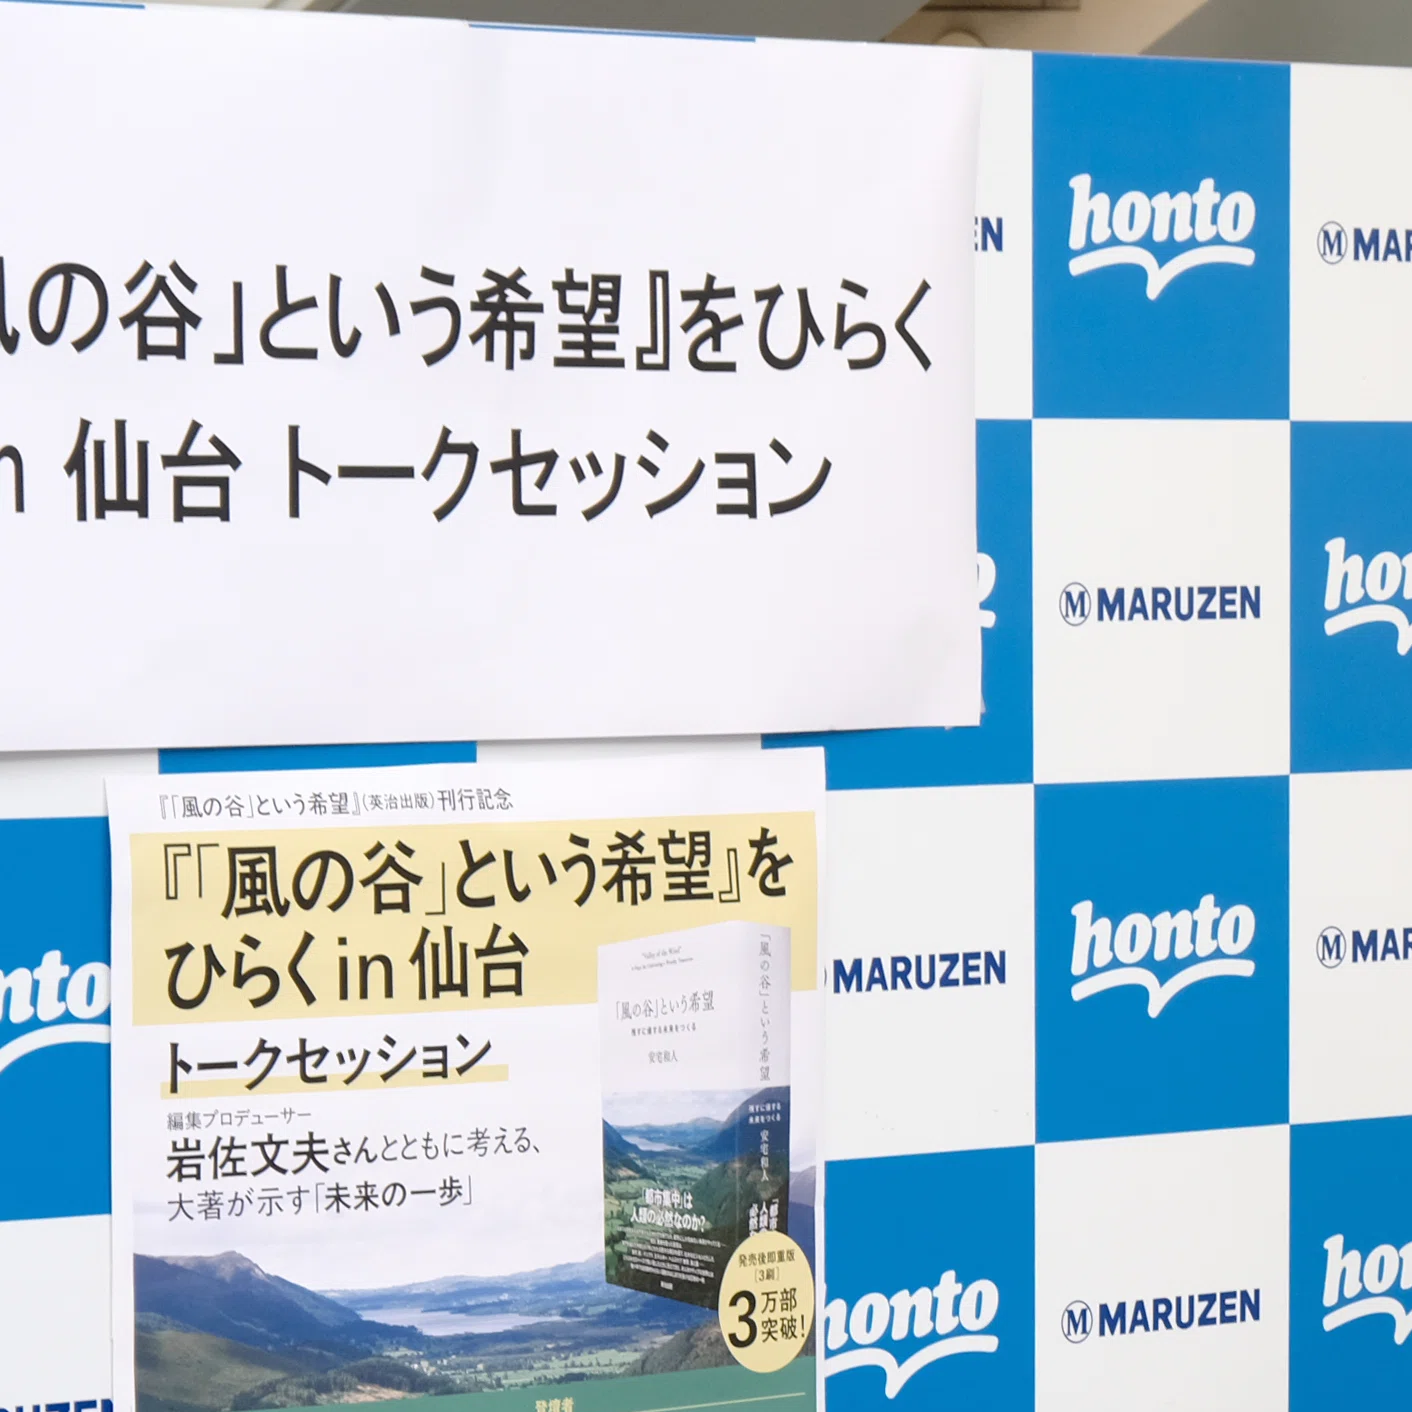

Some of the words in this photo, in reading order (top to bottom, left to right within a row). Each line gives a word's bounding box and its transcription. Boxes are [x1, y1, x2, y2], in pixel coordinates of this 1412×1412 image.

[1069, 173, 1256, 249] honto
[0, 258, 933, 373] の谷」という希望』をひらく
[63, 419, 242, 523] 仙台
[288, 424, 832, 522] トークセッション
[1097, 585, 1261, 622] MARUZEN
[164, 825, 795, 920] 『「風の谷」という希望』を
[1071, 894, 1256, 977] honto
[0, 950, 110, 1024] nto
[832, 950, 1007, 994] MARUZEN
[615, 990, 715, 1021] 「風の谷」という希望
[759, 933, 772, 1081] 「風の谷」という希望
[169, 1034, 492, 1094] トークセッション
[167, 1107, 312, 1131] 編集プロデューサー
[166, 1126, 540, 1182] 岩佐文夫さんとともに考える、
[168, 1175, 473, 1222] 大著が示す「未来の一歩」
[727, 1290, 758, 1348] 3
[761, 1288, 798, 1315] 万部
[1099, 1289, 1261, 1338] MARUZEN
